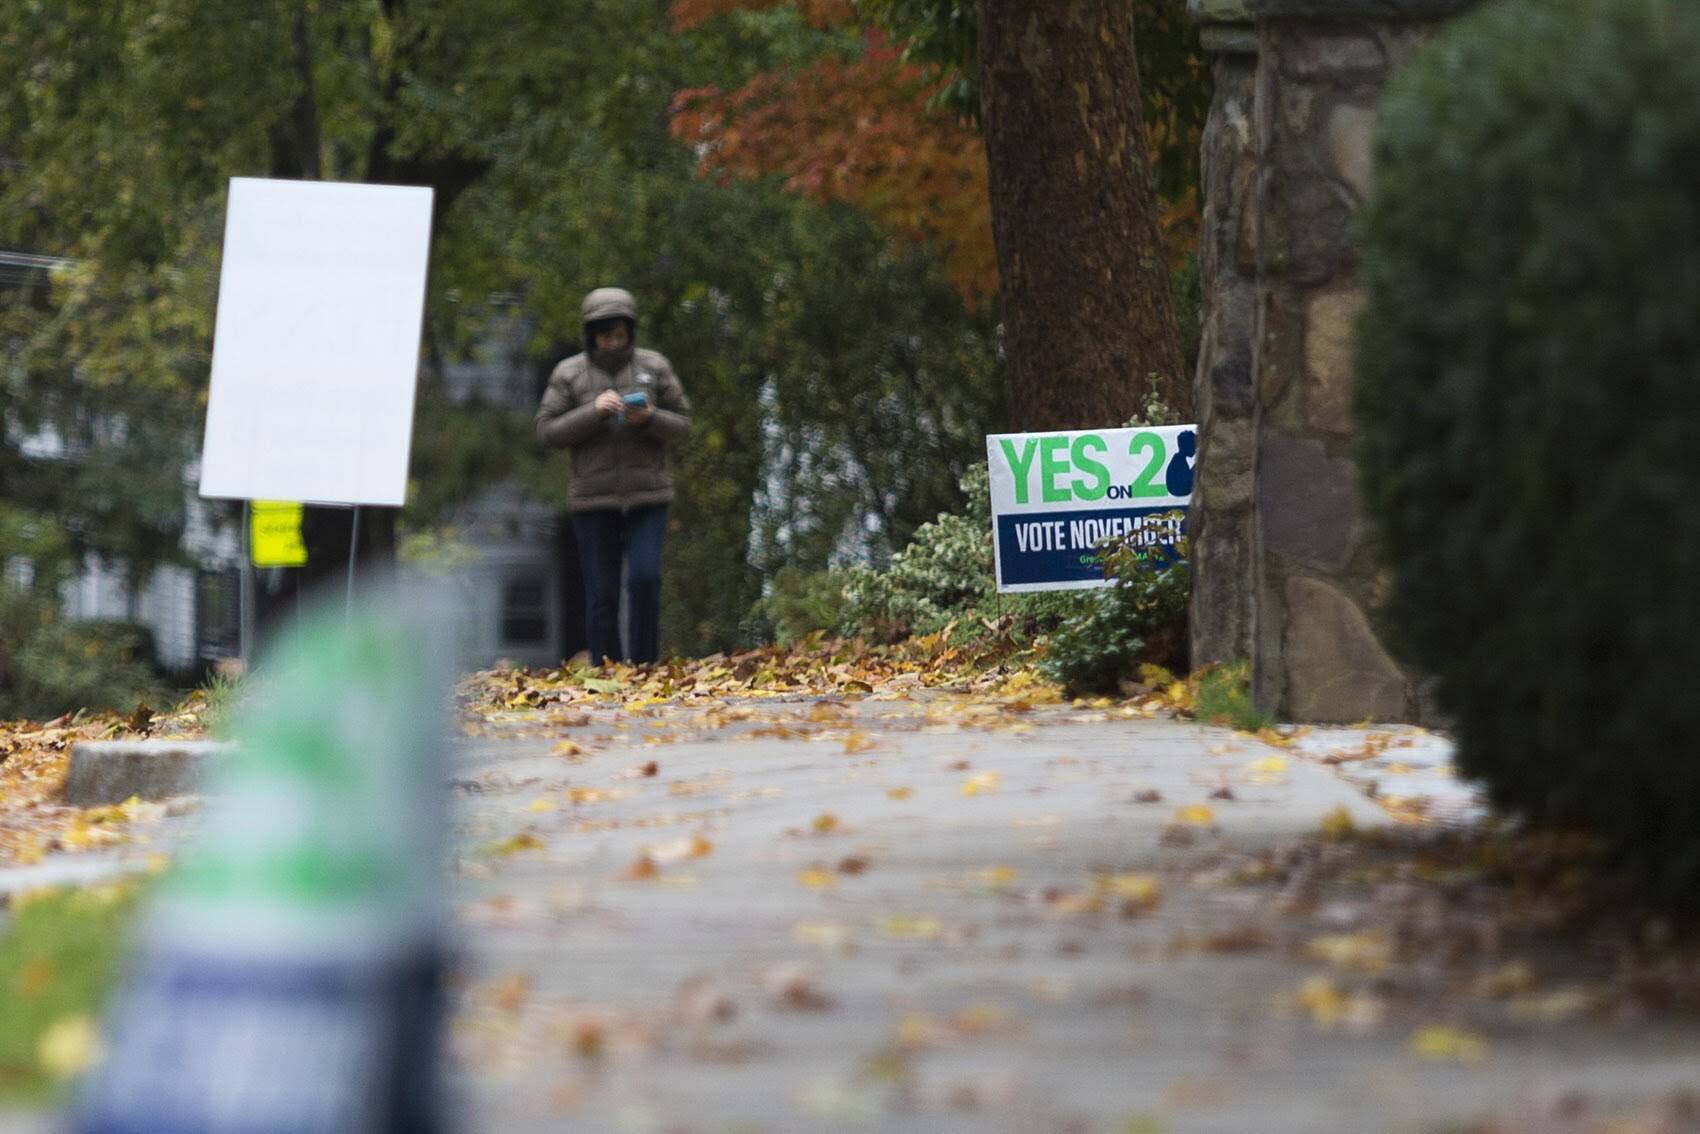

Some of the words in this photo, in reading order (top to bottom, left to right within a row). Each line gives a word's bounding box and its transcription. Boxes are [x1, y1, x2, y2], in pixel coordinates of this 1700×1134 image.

[999, 434, 1110, 504] YES
[1106, 485, 1133, 499] ON
[1129, 431, 1169, 498] 2
[1015, 521, 1066, 552] VOTE
